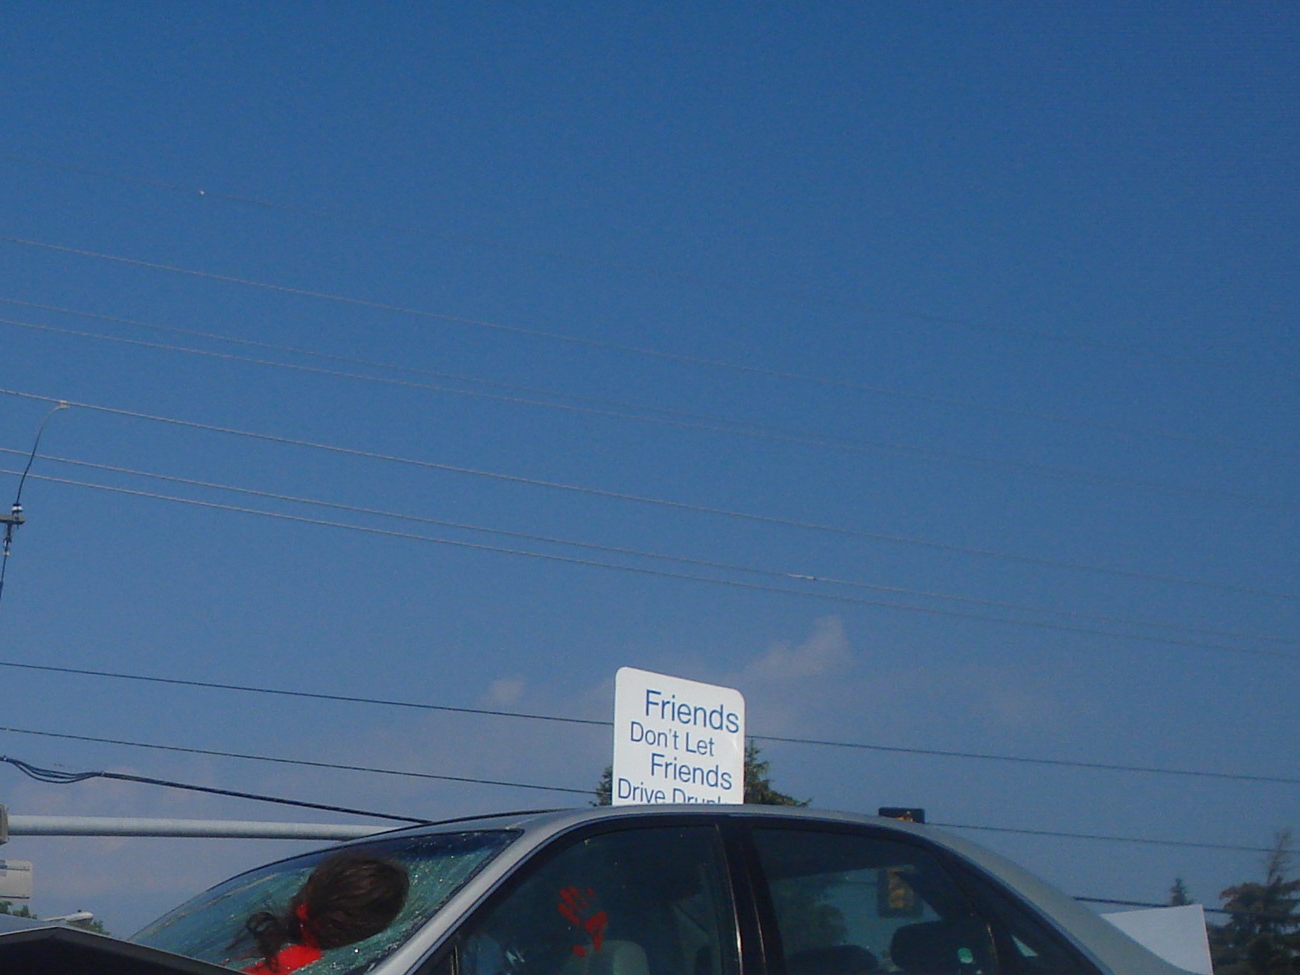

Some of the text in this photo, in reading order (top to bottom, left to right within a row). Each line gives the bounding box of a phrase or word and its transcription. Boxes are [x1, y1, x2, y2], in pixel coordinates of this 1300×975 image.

[645, 689, 739, 734] Friends
[630, 721, 715, 757] Don't Let
[651, 753, 732, 790] Friends
[618, 778, 666, 803] Drive
